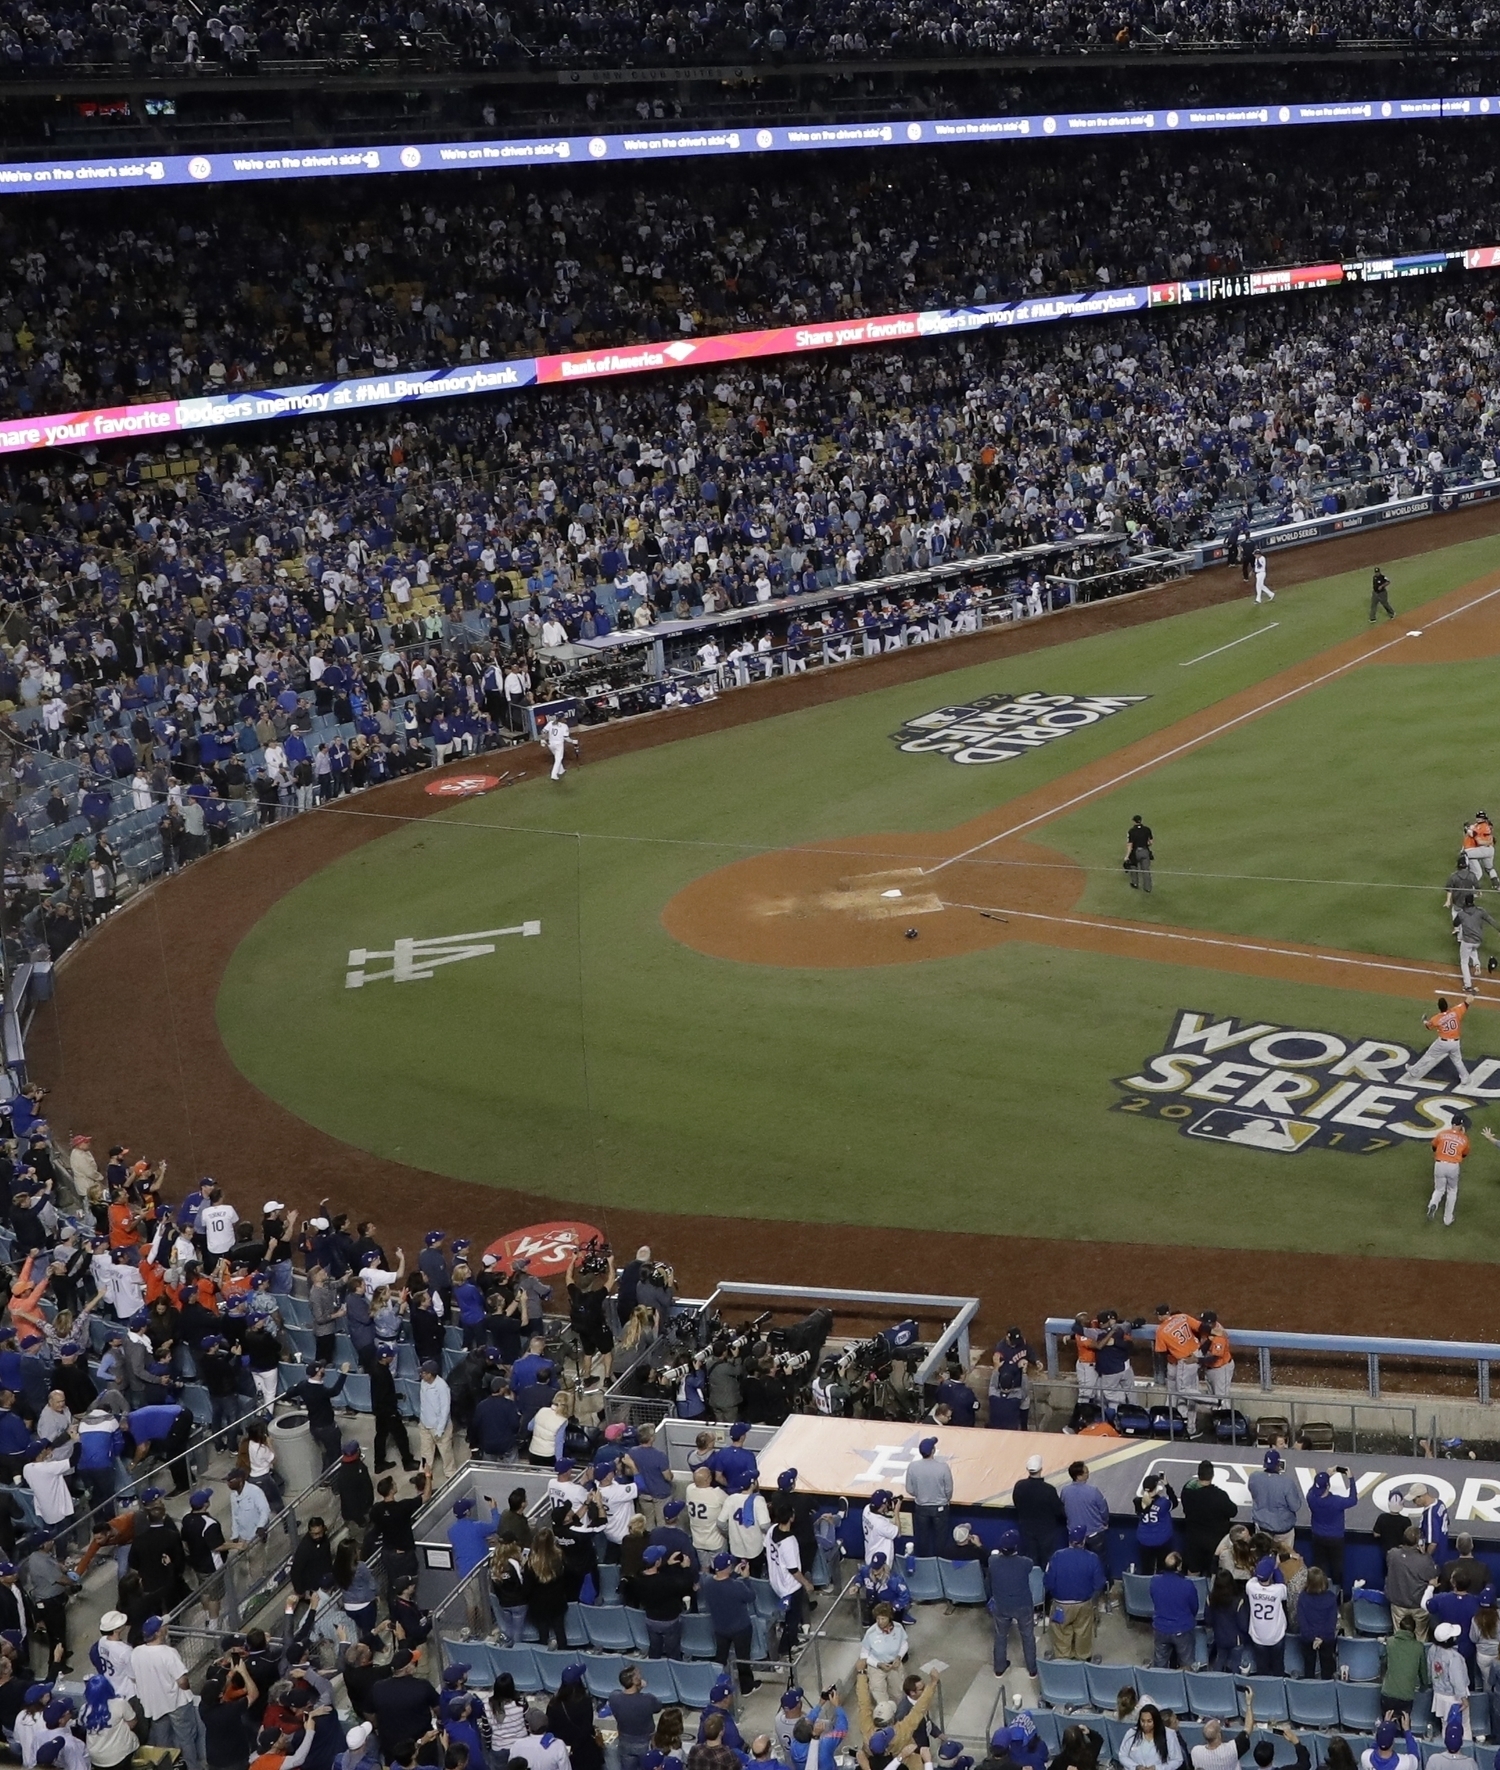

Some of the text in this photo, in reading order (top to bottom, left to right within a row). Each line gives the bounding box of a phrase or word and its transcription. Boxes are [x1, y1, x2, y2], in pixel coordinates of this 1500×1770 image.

[440, 144, 555, 161] We're on the driver's side
[233, 154, 362, 171] We're on the driver's side
[0, 164, 144, 183] We're on the driver's side
[1347, 271, 1357, 281] 96
[796, 293, 1136, 346] Share your favorite Dodgers memory at #MLBmemorybank
[561, 359, 597, 377] Bank
[610, 352, 663, 370] America
[44, 366, 518, 446] your favorite Dodgers memory at #MLBmemorybank
[1390, 502, 1429, 516] WORLD SERIES
[1276, 528, 1317, 543] WORLD SERIES
[900, 692, 1075, 754] SERIES
[953, 696, 1153, 764] WORLD
[1442, 1019, 1458, 1032] 30
[1122, 1053, 1478, 1139] SERIES
[1443, 1140, 1457, 1156] 15
[212, 1220, 224, 1232] 10
[513, 1236, 577, 1263] WS
[1171, 1323, 1191, 1346] 37
[689, 1501, 708, 1519] 32
[1142, 1511, 1158, 1523] 35
[1254, 1603, 1274, 1620] 22
